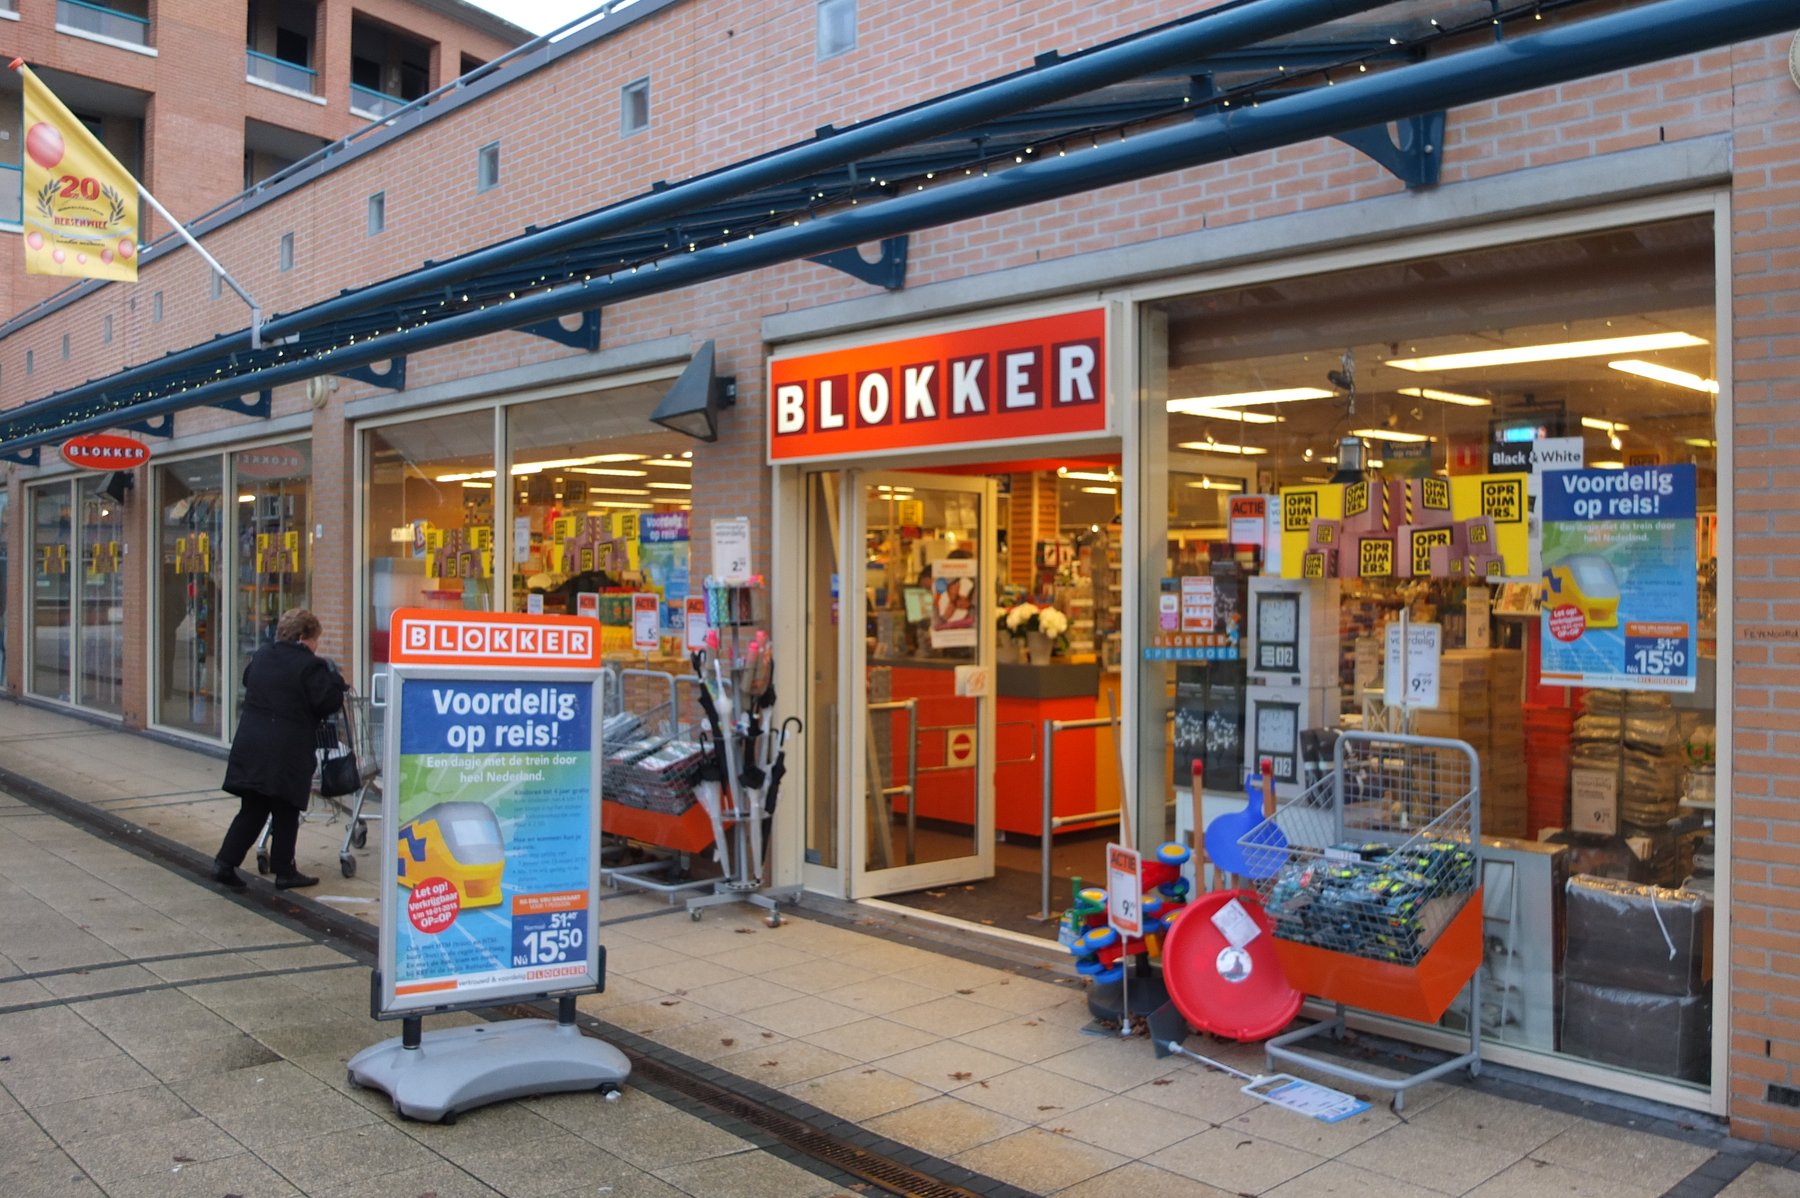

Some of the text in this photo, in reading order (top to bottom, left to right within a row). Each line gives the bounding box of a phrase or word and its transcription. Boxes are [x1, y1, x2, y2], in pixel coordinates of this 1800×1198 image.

[60, 175, 100, 201] 20
[777, 345, 1096, 434] BLOKKER
[69, 445, 144, 458] BLOKKER
[1492, 450, 1581, 466] Black & White
[1486, 485, 1515, 495] OPR
[1562, 470, 1673, 495] Voordelig
[1232, 501, 1264, 514] ACTIE
[1288, 496, 1312, 506] OPR
[1486, 497, 1514, 507] UIM
[1573, 494, 1660, 519] op reis!
[1288, 508, 1312, 516] UIM
[1363, 542, 1389, 552] OPR
[1415, 533, 1447, 546] OPR
[1363, 554, 1389, 563] UIM
[1363, 564, 1389, 574] ERS.
[411, 627, 585, 651] BLOKKER
[1154, 635, 1225, 645] BLOKKER
[1145, 648, 1238, 659] SPEELGOED
[1276, 647, 1292, 666] 12
[1634, 650, 1685, 674] 15.50
[432, 688, 576, 720] Voordelig
[447, 720, 559, 752] op reis!
[427, 754, 577, 769] Een dagje met de trein door
[460, 770, 545, 783] heel Nederland.
[1111, 849, 1136, 869] ACTIE
[415, 882, 448, 898] Let op!
[409, 892, 458, 911] Verkrijgbaar
[421, 911, 452, 927] OP=OP
[513, 955, 528, 966] Nú
[522, 928, 583, 964] 15.50
